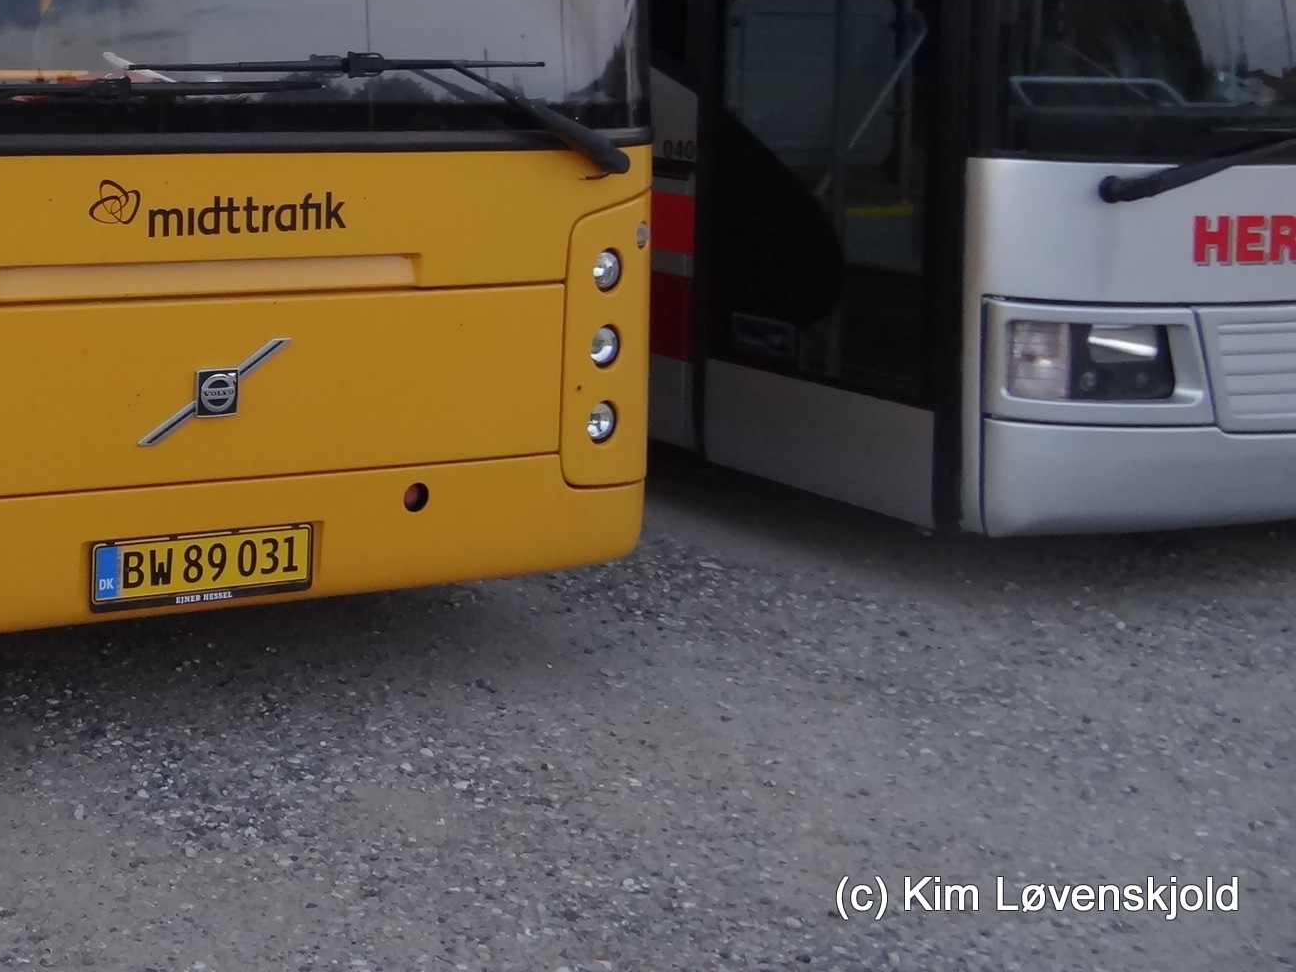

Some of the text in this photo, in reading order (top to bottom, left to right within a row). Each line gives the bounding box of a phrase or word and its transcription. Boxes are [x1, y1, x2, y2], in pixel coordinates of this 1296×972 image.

[148, 191, 347, 238] midttrafik
[203, 389, 235, 398] VOLVO
[122, 536, 299, 589] BW 89 031
[99, 577, 115, 591] DK
[175, 591, 233, 605] EJNER HESSEL
